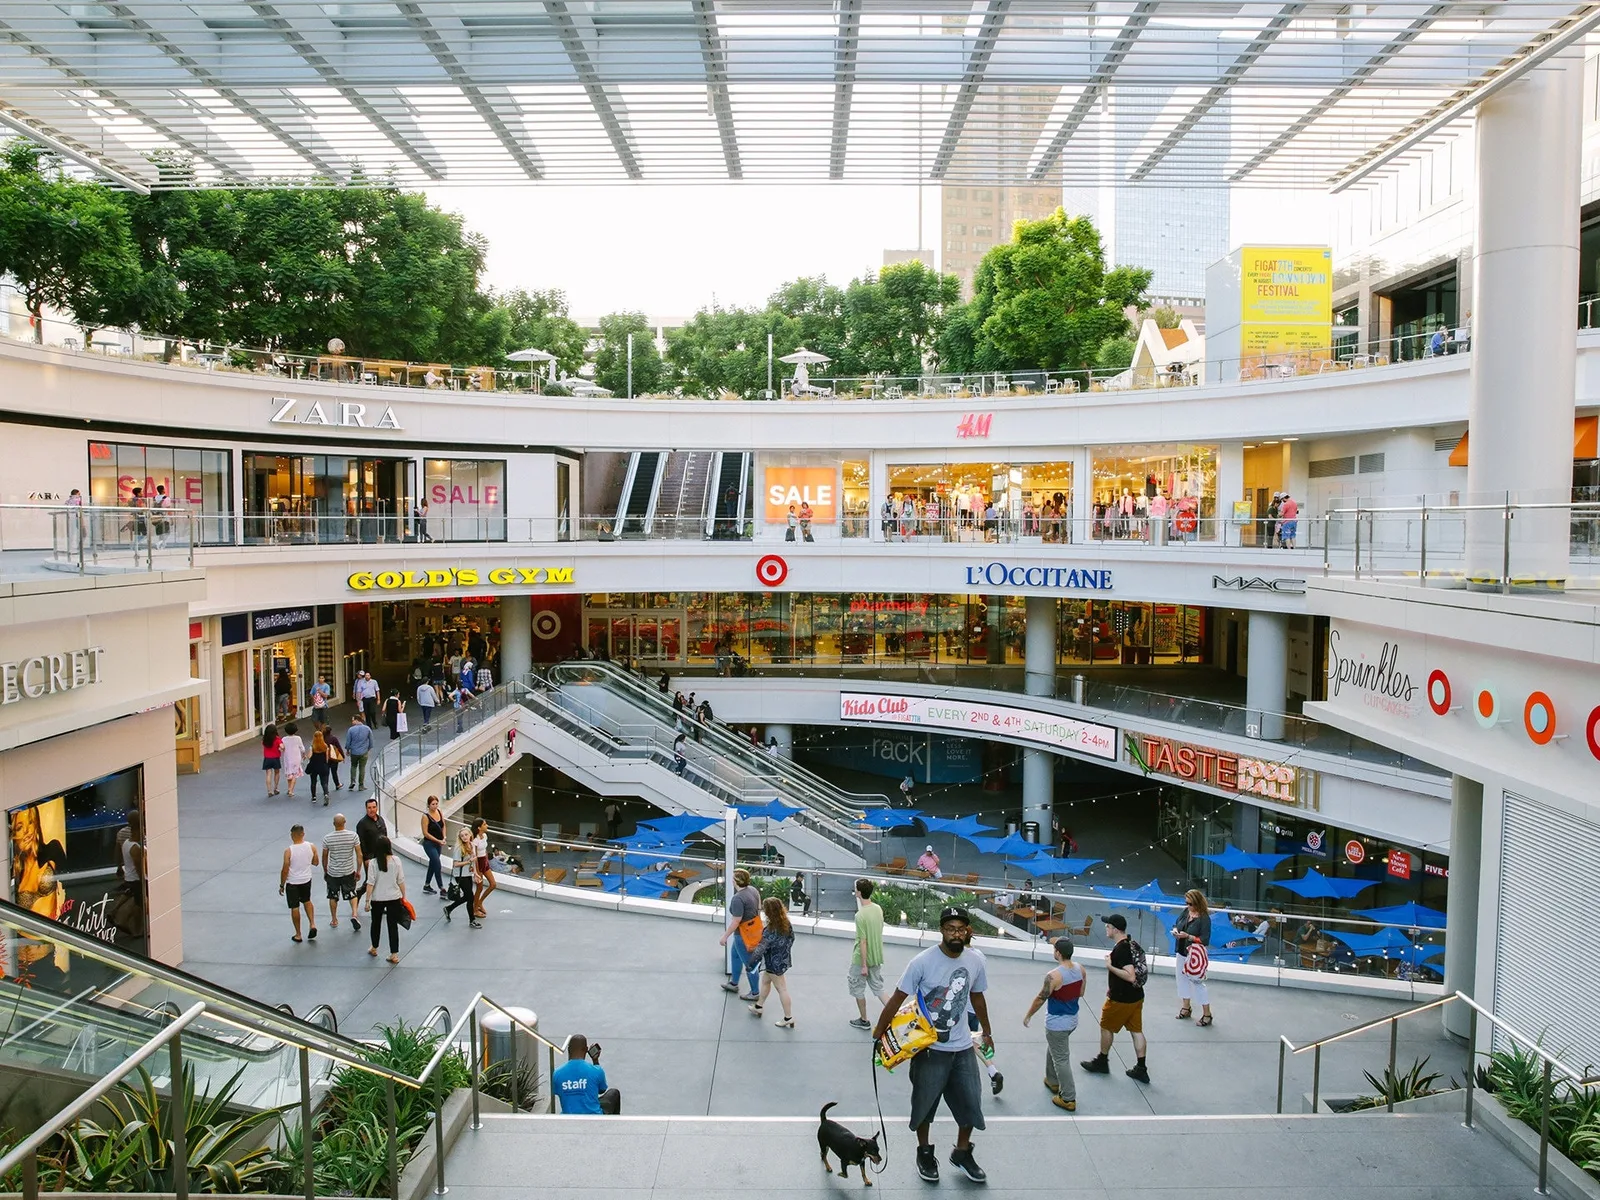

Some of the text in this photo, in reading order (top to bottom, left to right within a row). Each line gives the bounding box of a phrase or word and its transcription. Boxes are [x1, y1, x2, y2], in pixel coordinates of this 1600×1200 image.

[1258, 285, 1299, 297] FESTIVAL
[269, 397, 405, 430] ZARA
[956, 412, 993, 439] H&M
[27, 491, 60, 500] ZARA
[431, 484, 498, 504] SALE
[769, 485, 832, 506] SALE
[348, 567, 576, 590] GOLD'S GYM
[966, 562, 1113, 590] L'OCCITANE
[850, 599, 929, 616] pharmacy
[1328, 630, 1419, 701] Sprinkles
[842, 697, 908, 716] Kids Club
[1363, 692, 1410, 719] CUPCAKES
[928, 707, 1110, 749] EVERY 2ND & 4TH SATURDAY 2-4PM
[872, 736, 924, 765] rack
[946, 753, 968, 761] MORE.
[1143, 738, 1238, 788] TASTE
[1238, 758, 1295, 784] FOOD
[1238, 774, 1296, 801] HALL
[1392, 853, 1406, 862] New
[1425, 864, 1443, 876] FIVE
[562, 1078, 587, 1090] staff
